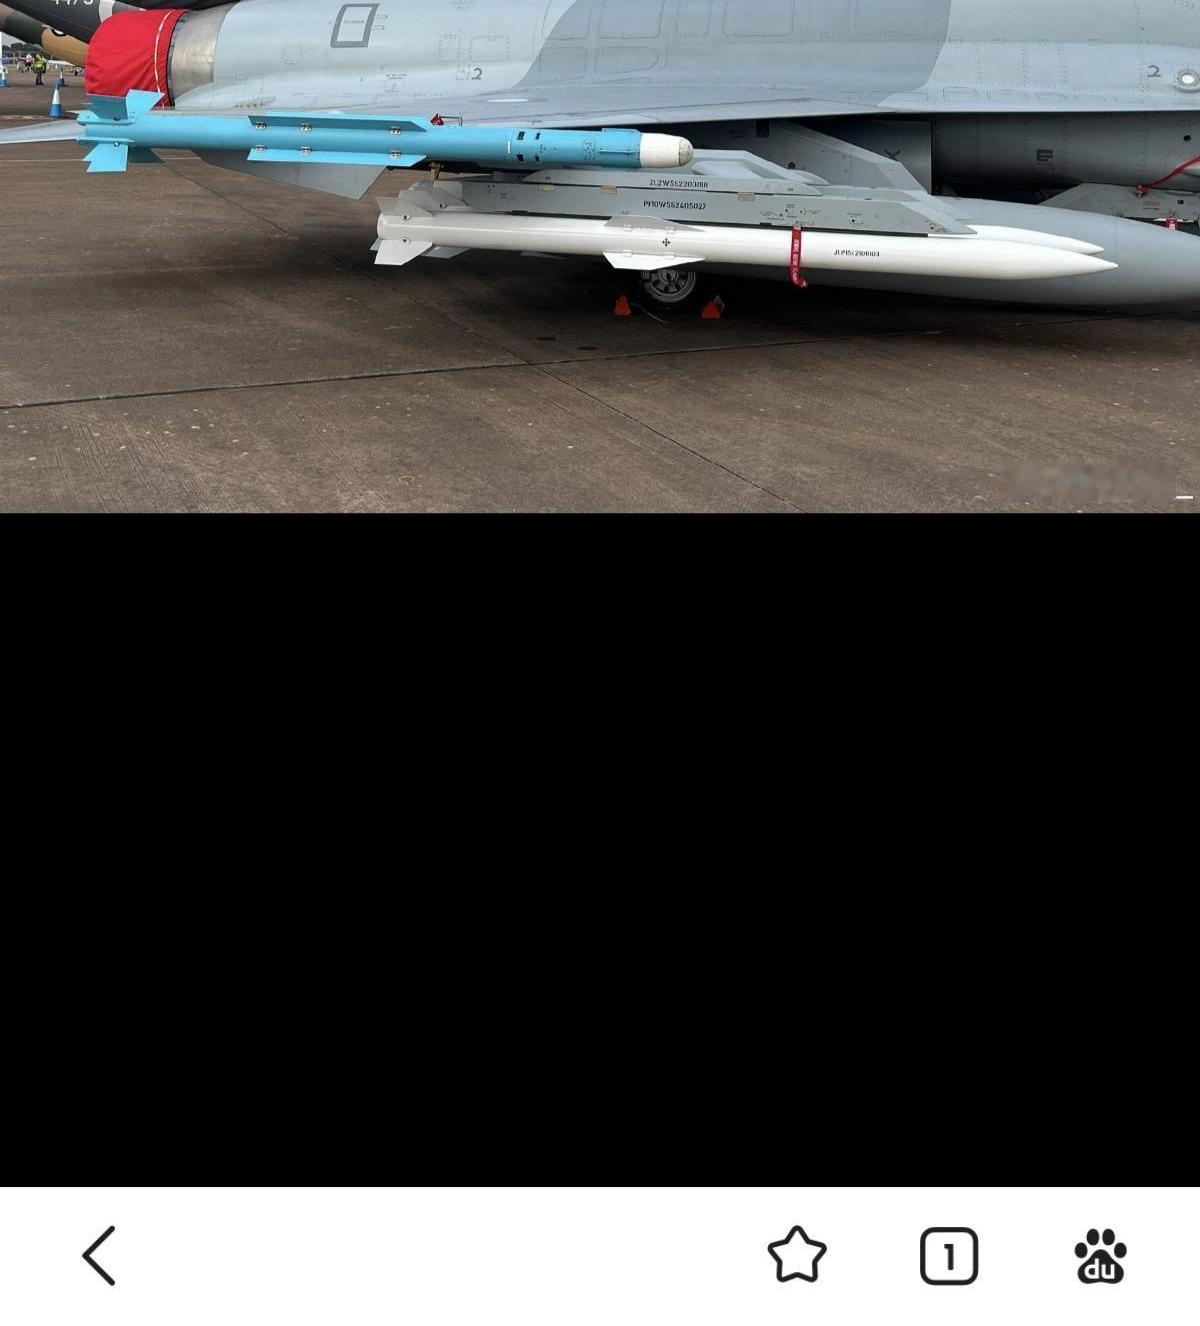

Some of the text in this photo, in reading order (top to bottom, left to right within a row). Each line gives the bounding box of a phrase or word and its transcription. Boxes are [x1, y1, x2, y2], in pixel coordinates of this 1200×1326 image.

[471, 67, 482, 80] 2
[1147, 65, 1161, 78] 2
[943, 1243, 954, 1271] 1
[1084, 1258, 1115, 1280] du
